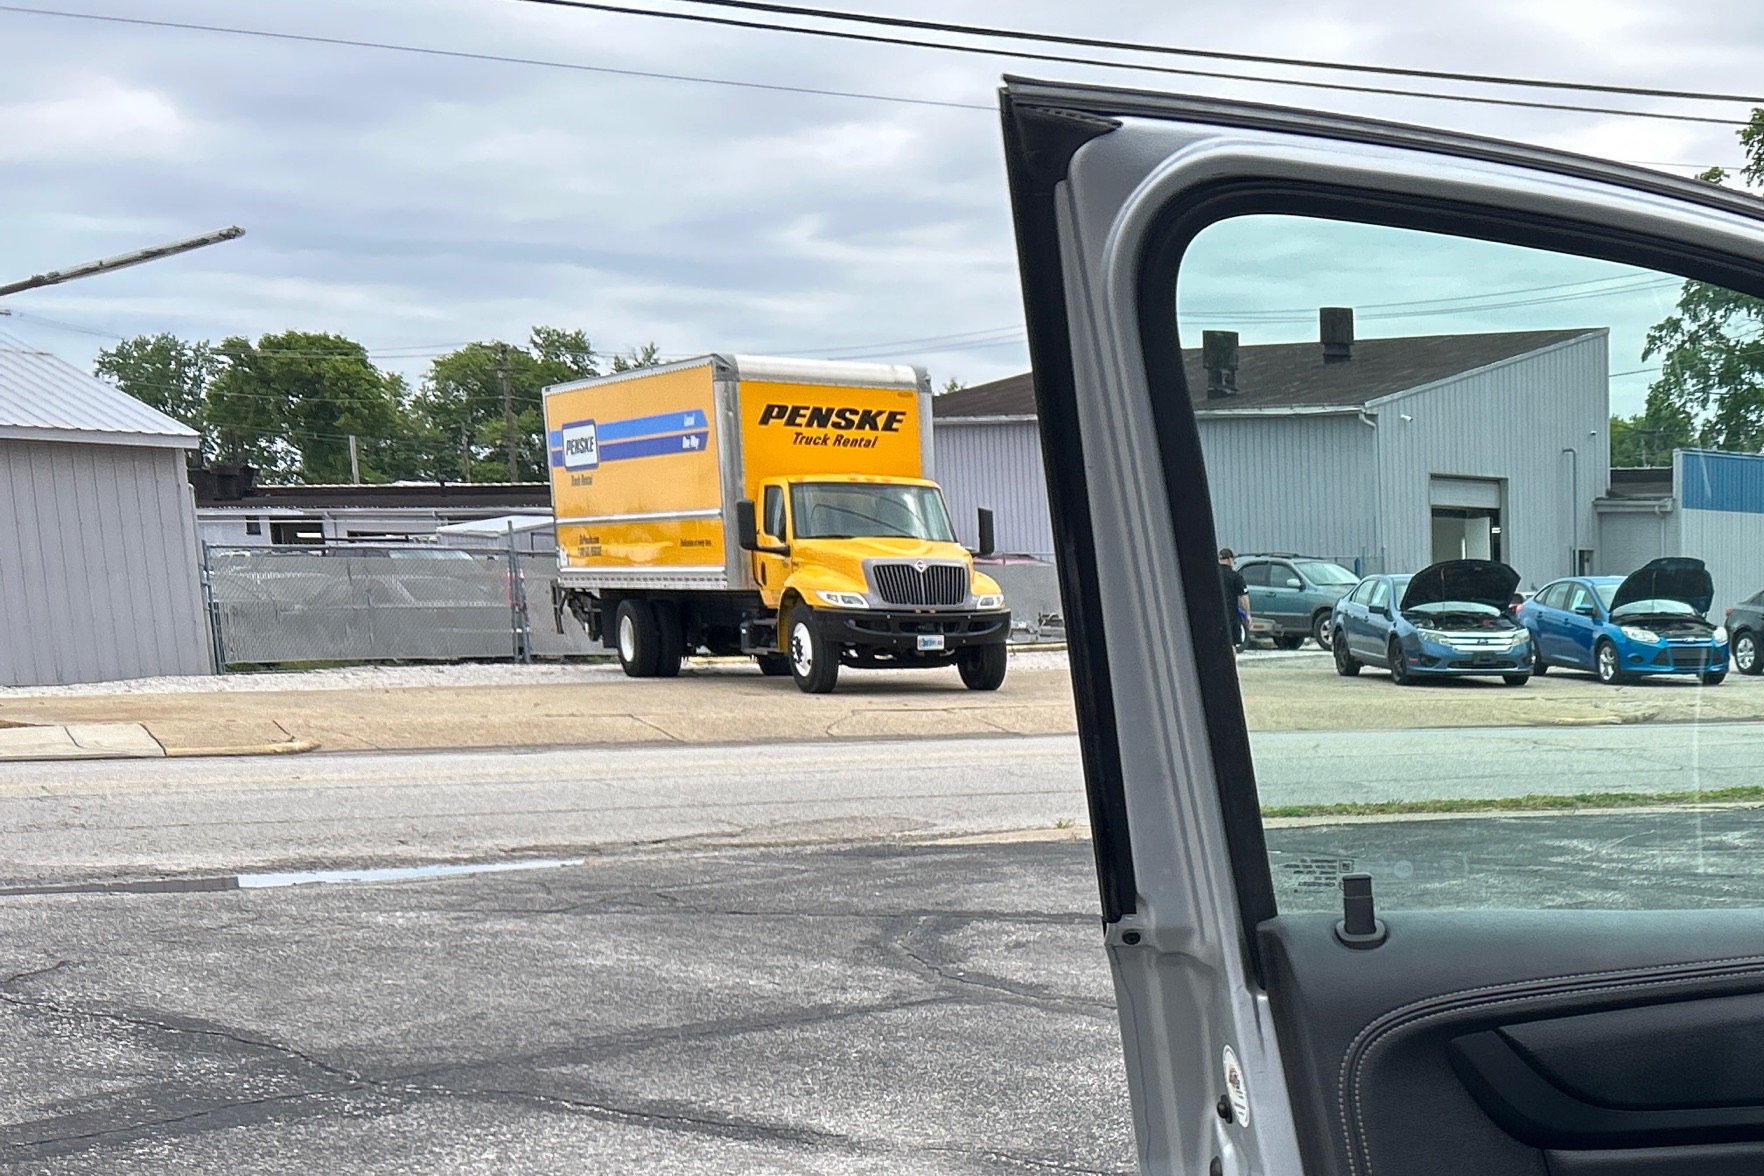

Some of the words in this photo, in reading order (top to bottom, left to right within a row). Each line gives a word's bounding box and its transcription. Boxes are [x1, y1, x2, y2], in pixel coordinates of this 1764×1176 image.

[758, 403, 907, 432] PENSKE
[566, 436, 594, 456] PENSKE
[793, 432, 831, 446] Truck
[833, 434, 879, 449] Rental
